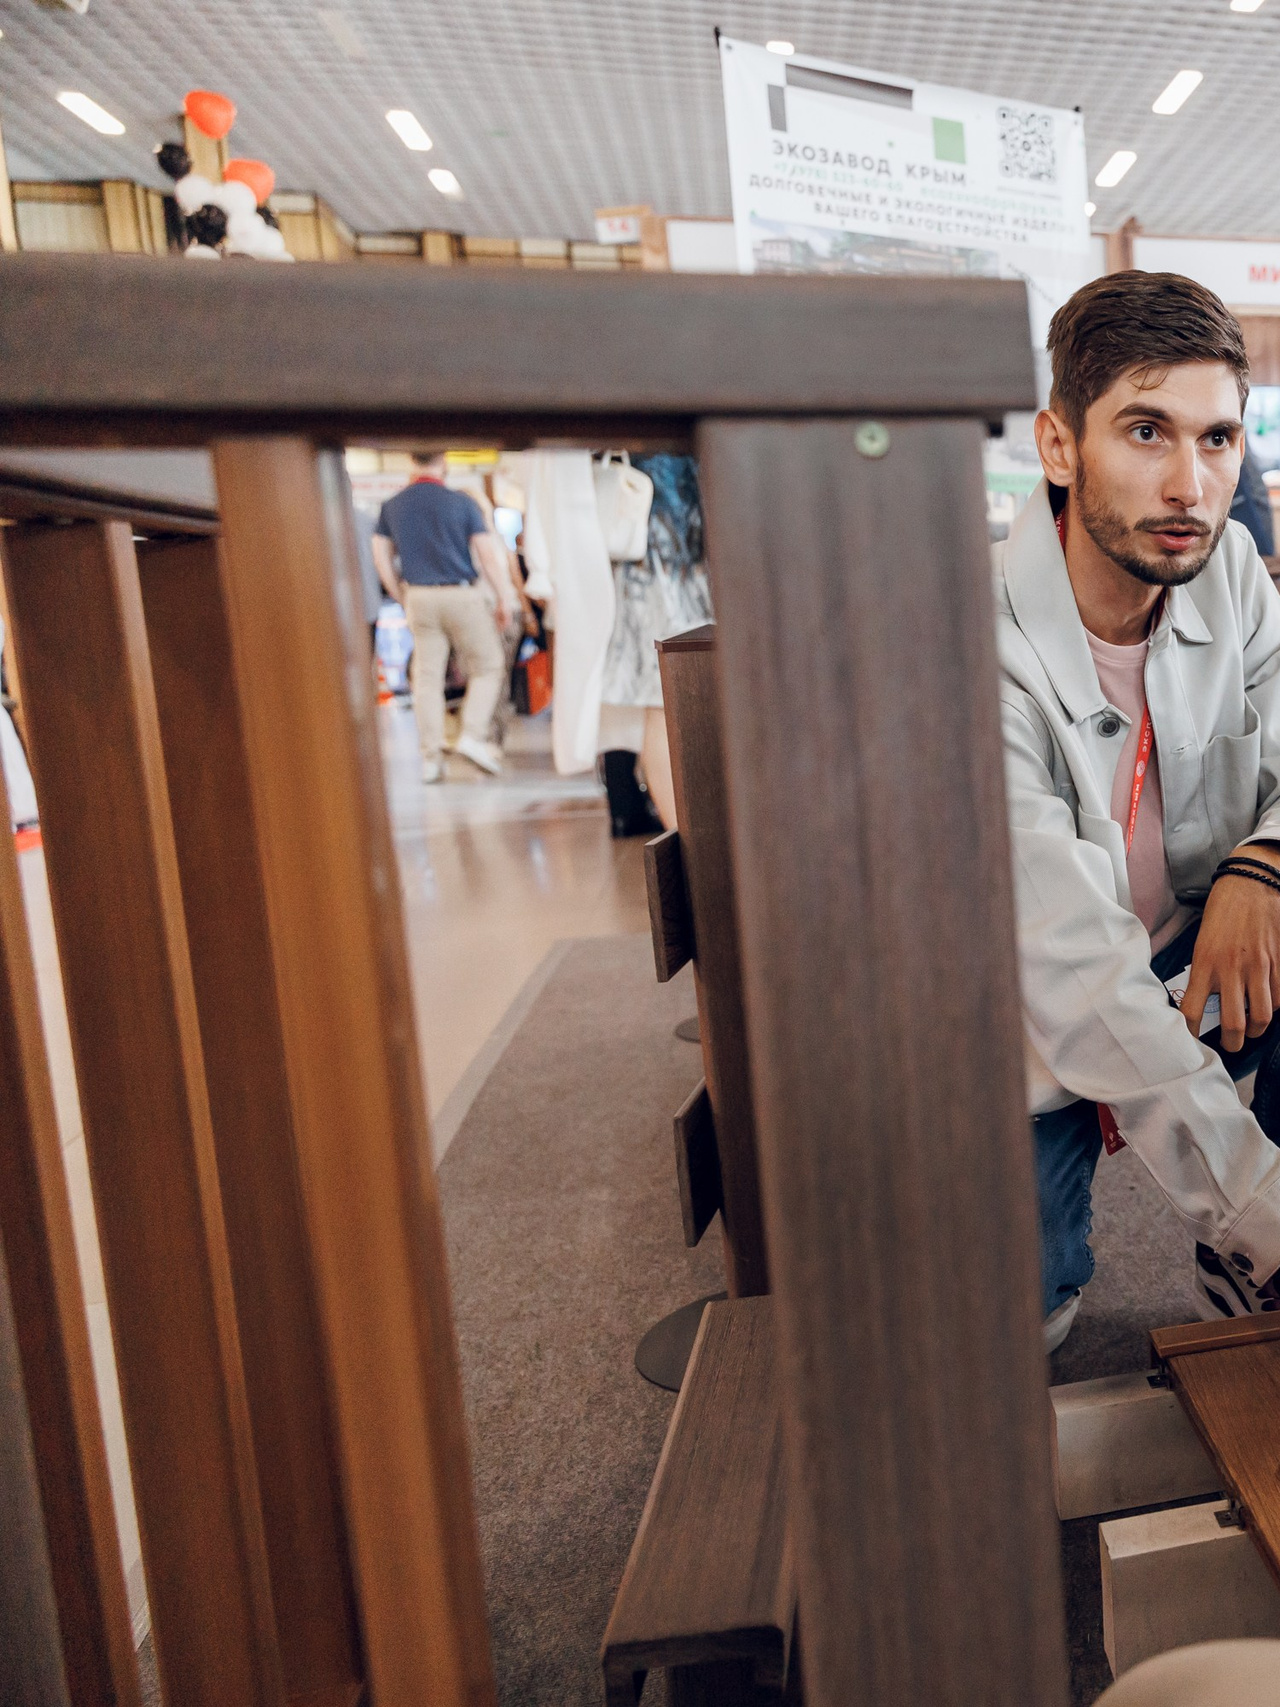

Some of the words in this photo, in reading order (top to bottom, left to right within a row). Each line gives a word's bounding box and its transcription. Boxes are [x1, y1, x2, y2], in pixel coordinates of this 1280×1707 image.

[772, 139, 892, 176] ЭКОЗАВОД
[905, 163, 967, 186] КРЫМ
[749, 174, 872, 205] ДОЛГОВЕЧНЫЕ
[895, 197, 1006, 225] ЭКОЛОГИЧНЫЕ
[814, 201, 880, 222] ВАШЕГО
[885, 212, 1029, 243] БЛАГОУСТРОЙСТВА
